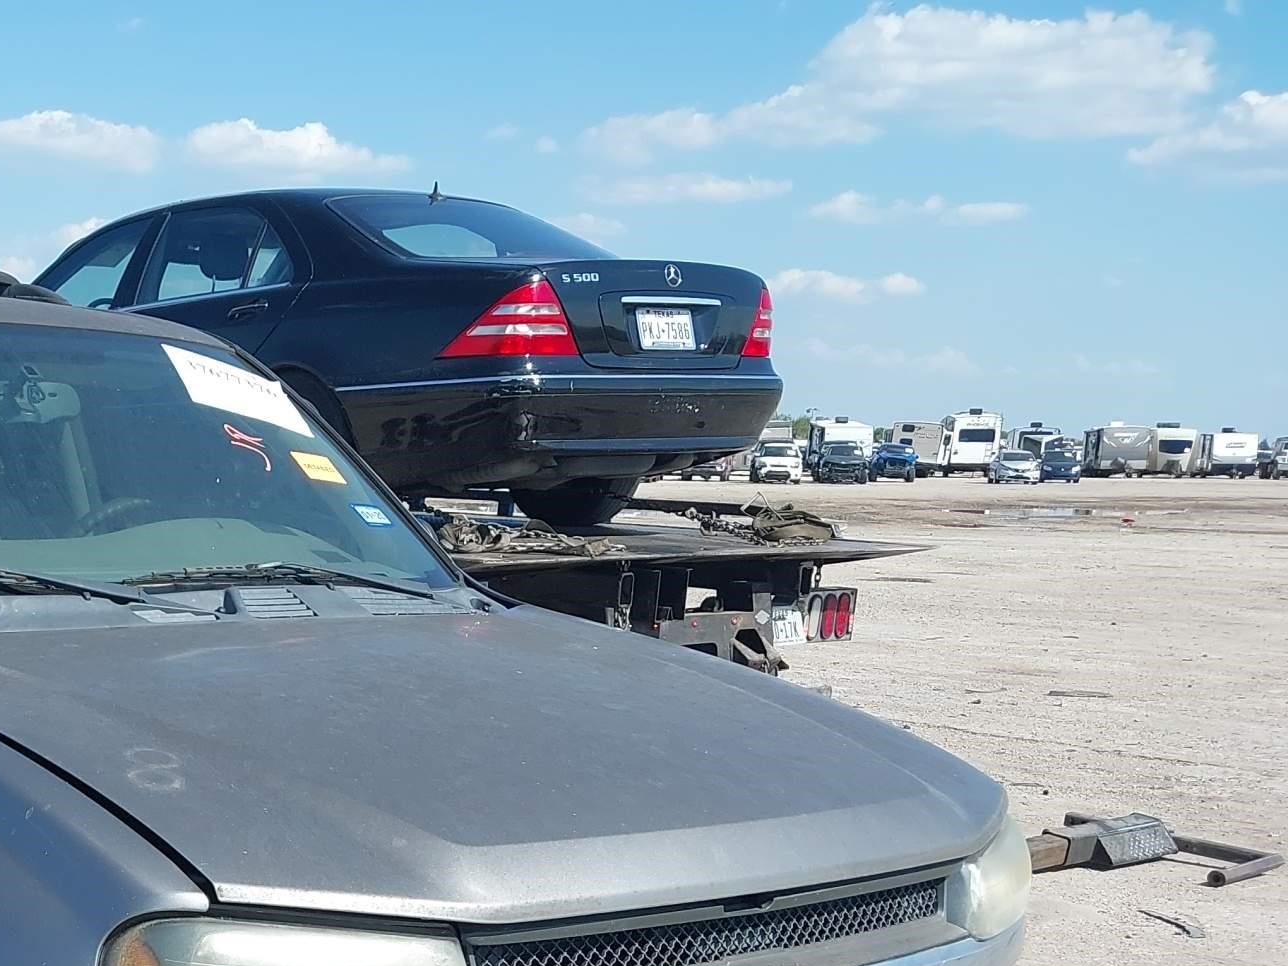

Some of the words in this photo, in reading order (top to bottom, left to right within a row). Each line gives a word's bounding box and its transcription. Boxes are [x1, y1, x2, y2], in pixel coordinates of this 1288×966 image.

[561, 273, 571, 283] S
[573, 272, 600, 282] 500
[653, 310, 674, 319] TEXAS
